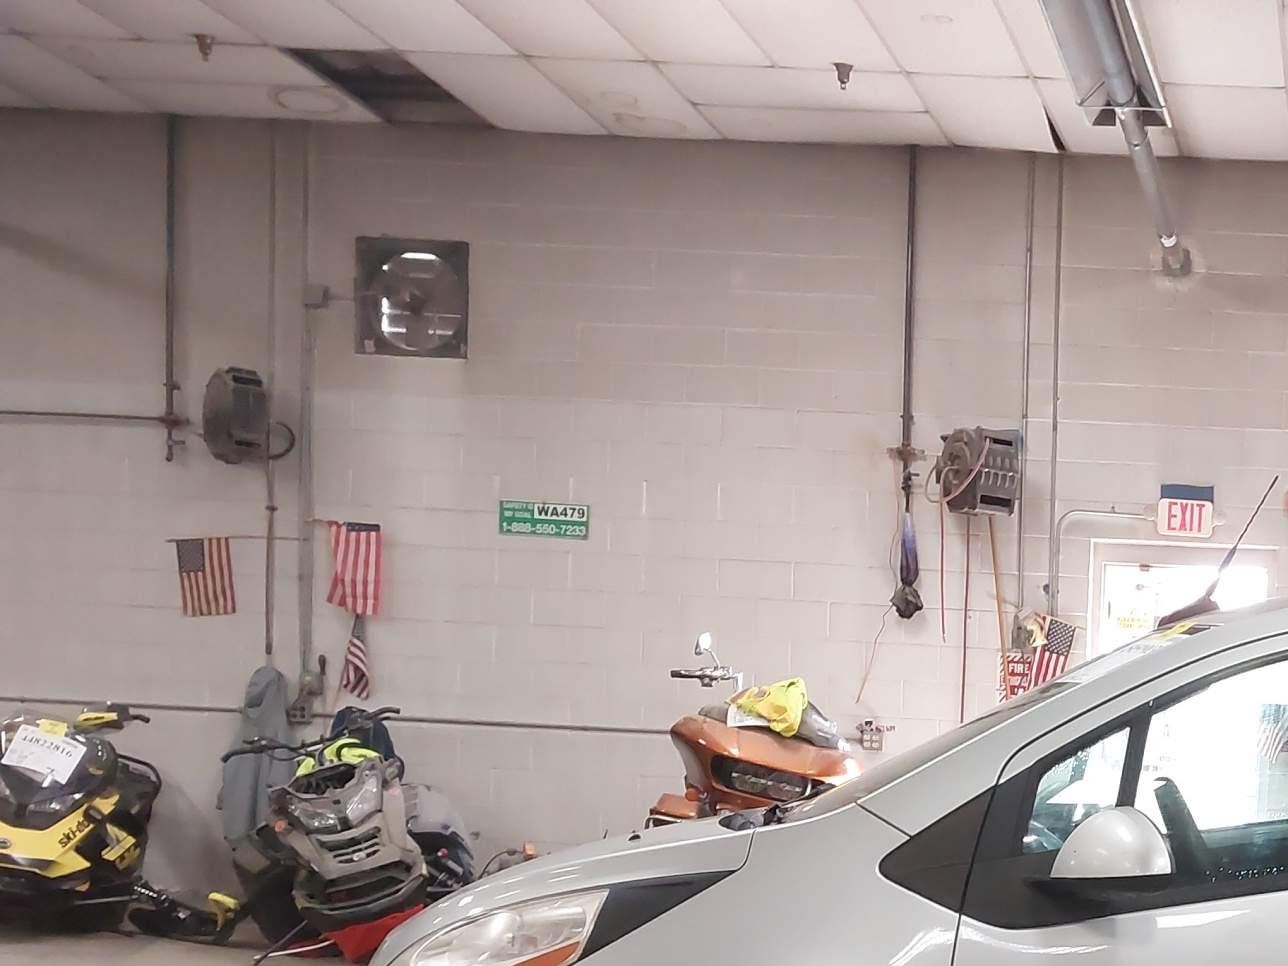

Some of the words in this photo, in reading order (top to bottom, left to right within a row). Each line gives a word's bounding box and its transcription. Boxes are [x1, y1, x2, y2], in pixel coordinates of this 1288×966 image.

[537, 505, 586, 520] WA479
[1167, 501, 1206, 533] EXIT
[502, 521, 586, 536] 1-888-550-7233
[1008, 662, 1030, 674] FIRE
